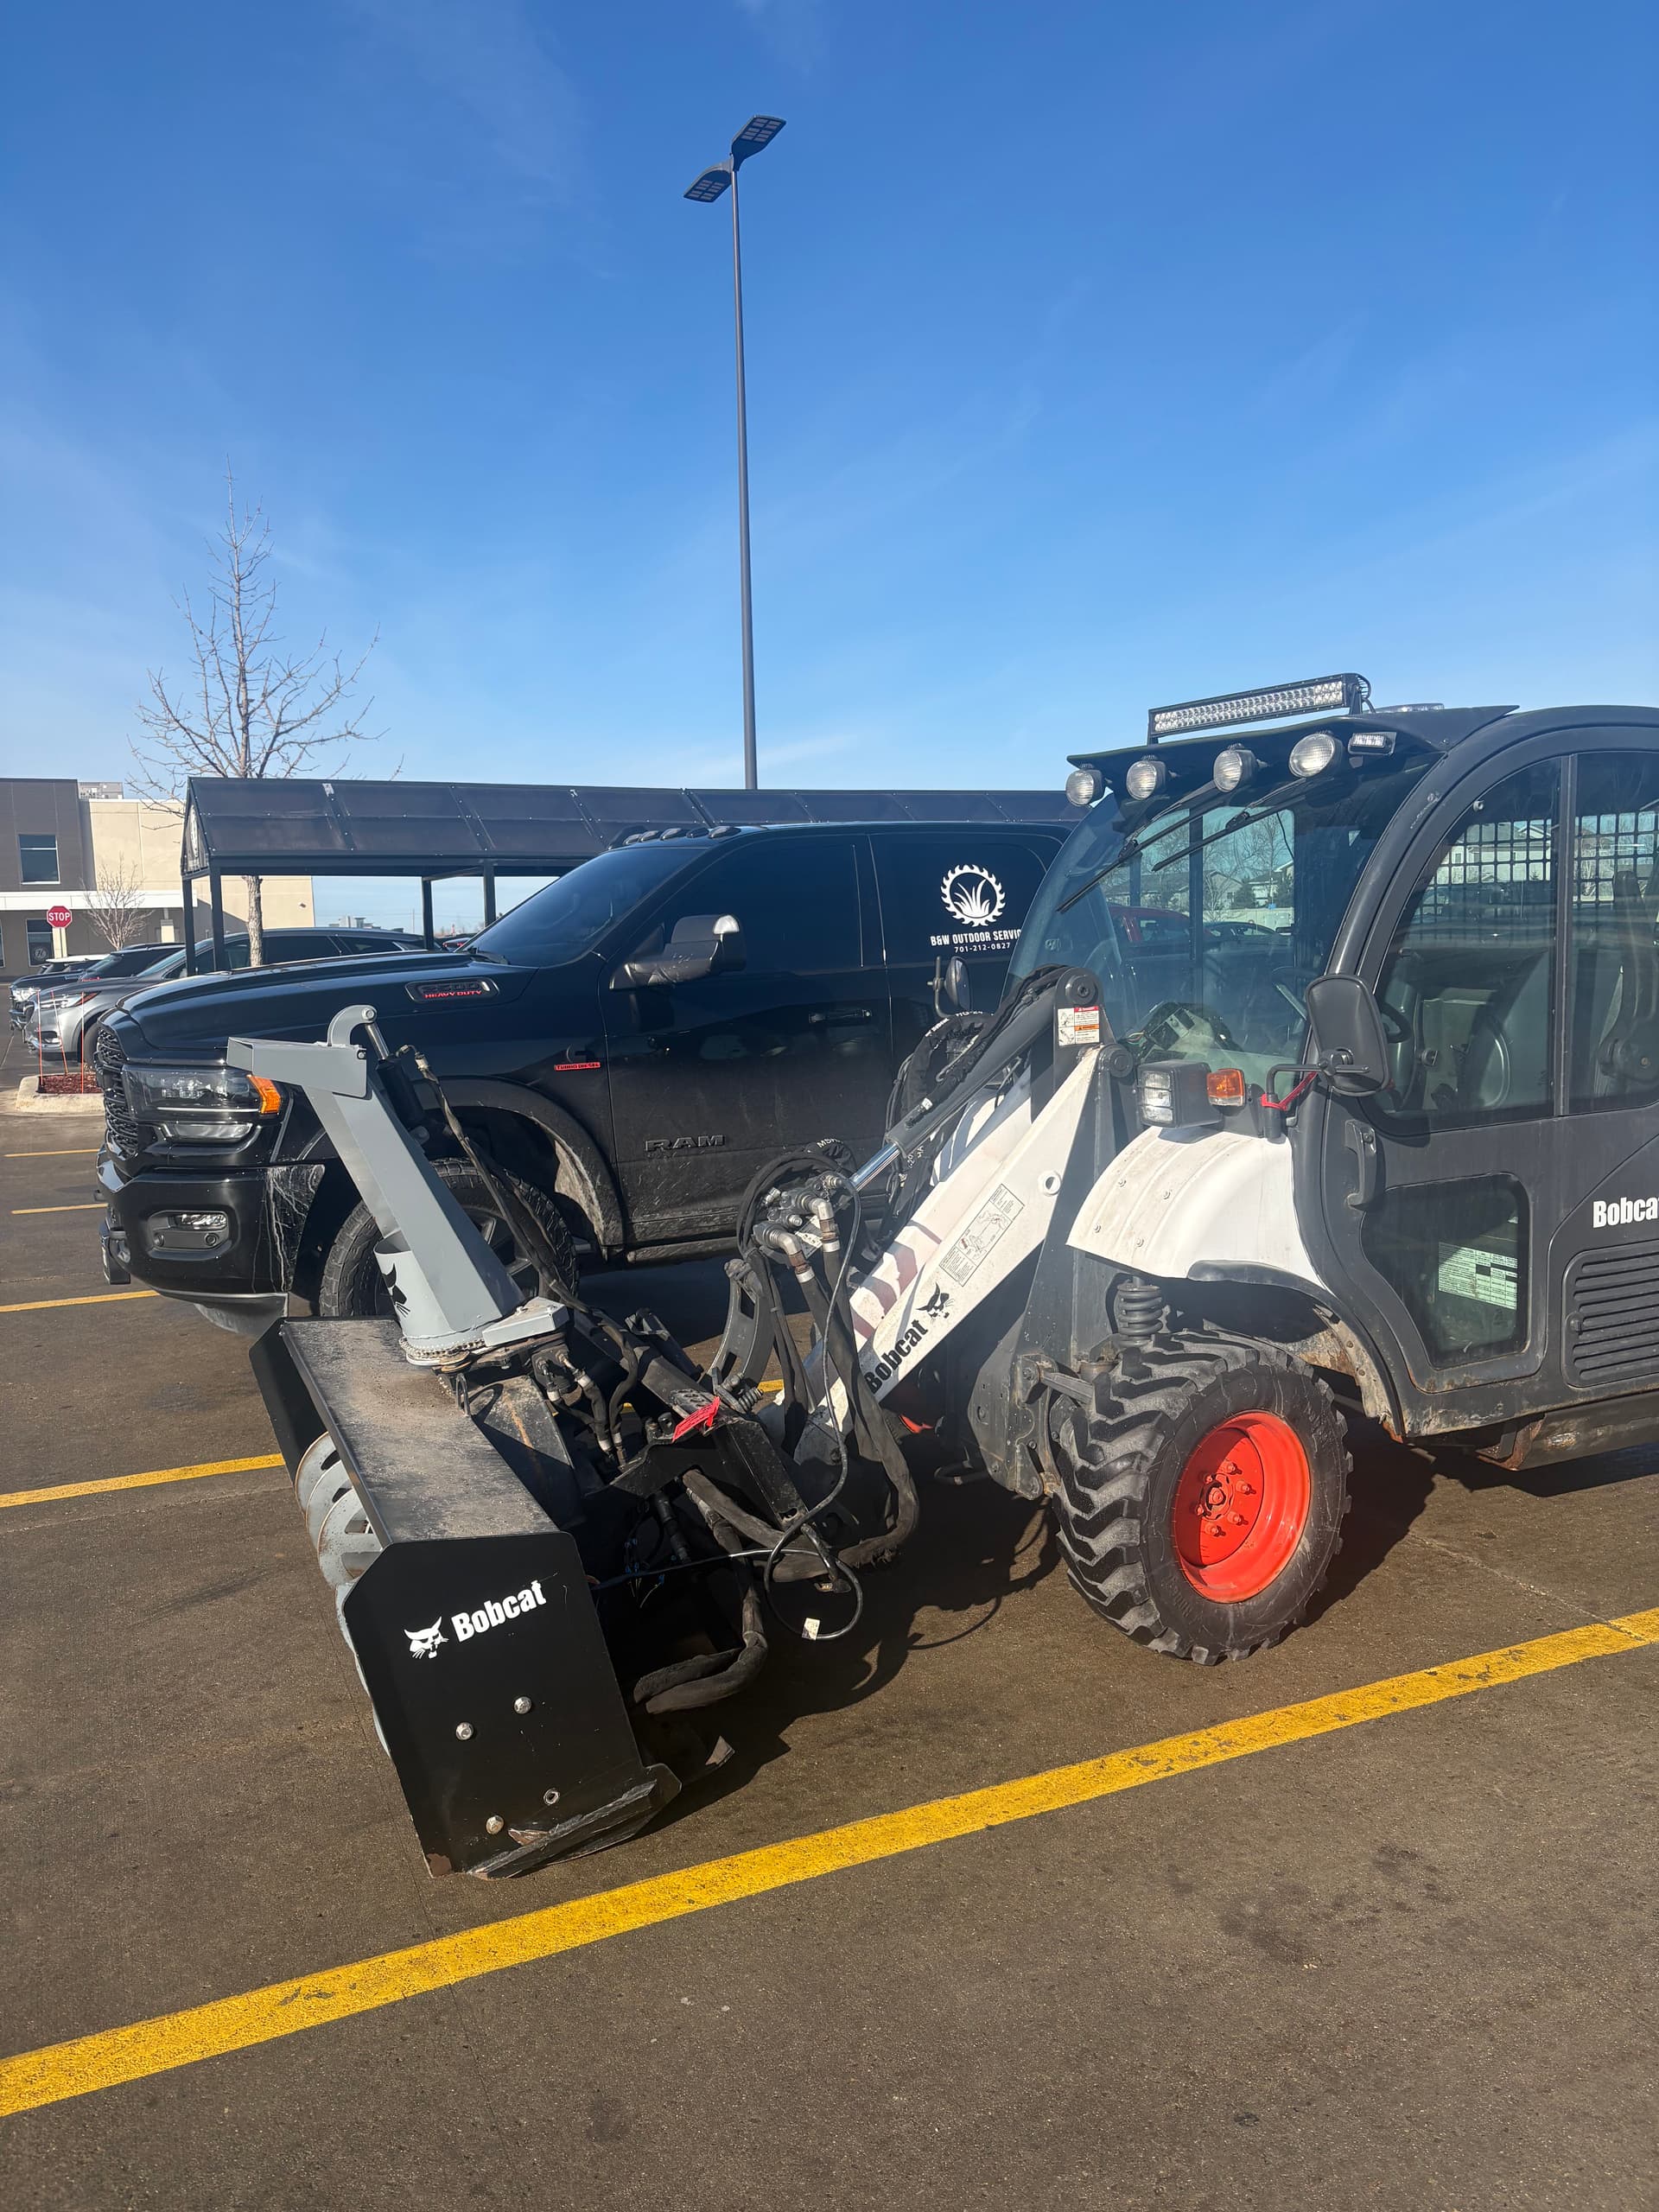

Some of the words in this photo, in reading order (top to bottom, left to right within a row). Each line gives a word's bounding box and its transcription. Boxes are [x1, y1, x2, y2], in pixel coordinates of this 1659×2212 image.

[48, 912, 71, 921] STOP
[930, 935, 950, 946] B&W
[952, 931, 991, 944] OUTDOOR
[954, 942, 1010, 953] 701-212-0827
[645, 1135, 725, 1152] RAM
[1592, 1197, 1659, 1229] Bobca
[864, 1319, 928, 1395] Bobcat
[451, 1580, 547, 1643] Bobcat
